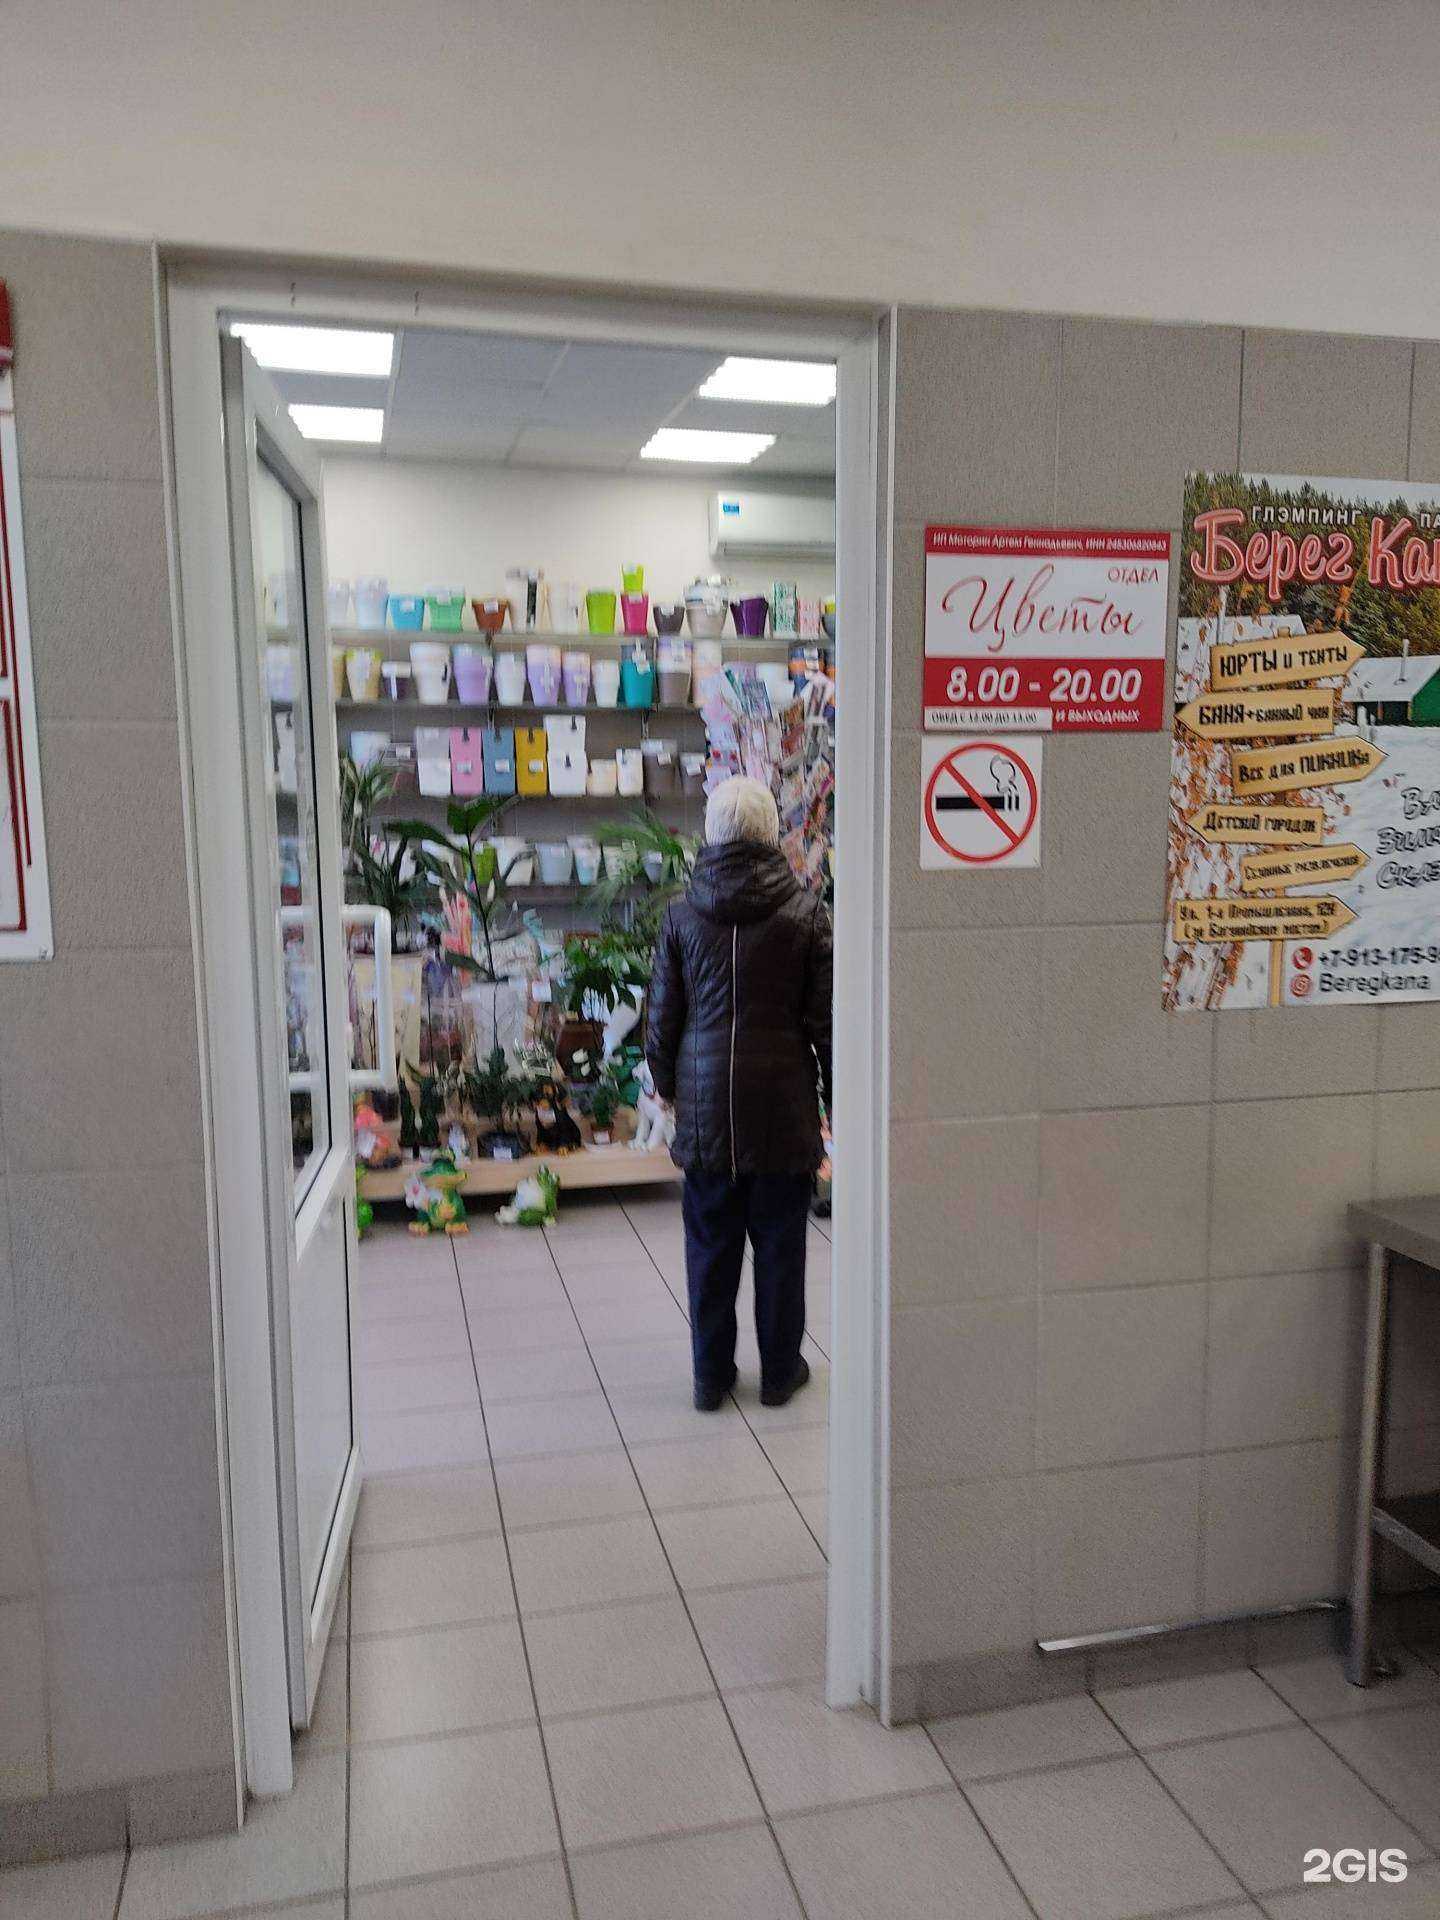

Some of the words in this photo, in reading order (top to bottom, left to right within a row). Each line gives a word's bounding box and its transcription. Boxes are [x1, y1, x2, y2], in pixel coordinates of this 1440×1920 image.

[1252, 505, 1362, 526] ГЛЭМПИНГ
[1190, 507, 1355, 601] Берег
[1108, 566, 1159, 585] ОТДЕЛ
[941, 563, 1143, 653] Цветы
[1219, 650, 1277, 677] ЮРТЫ
[1298, 646, 1348, 667] ТЕНТЫ
[946, 665, 1020, 702] 8.00
[1049, 667, 1143, 703] 20.00
[1068, 709, 1140, 725] ВЫХОДНЫХ
[1320, 971, 1431, 997] Beregkana
